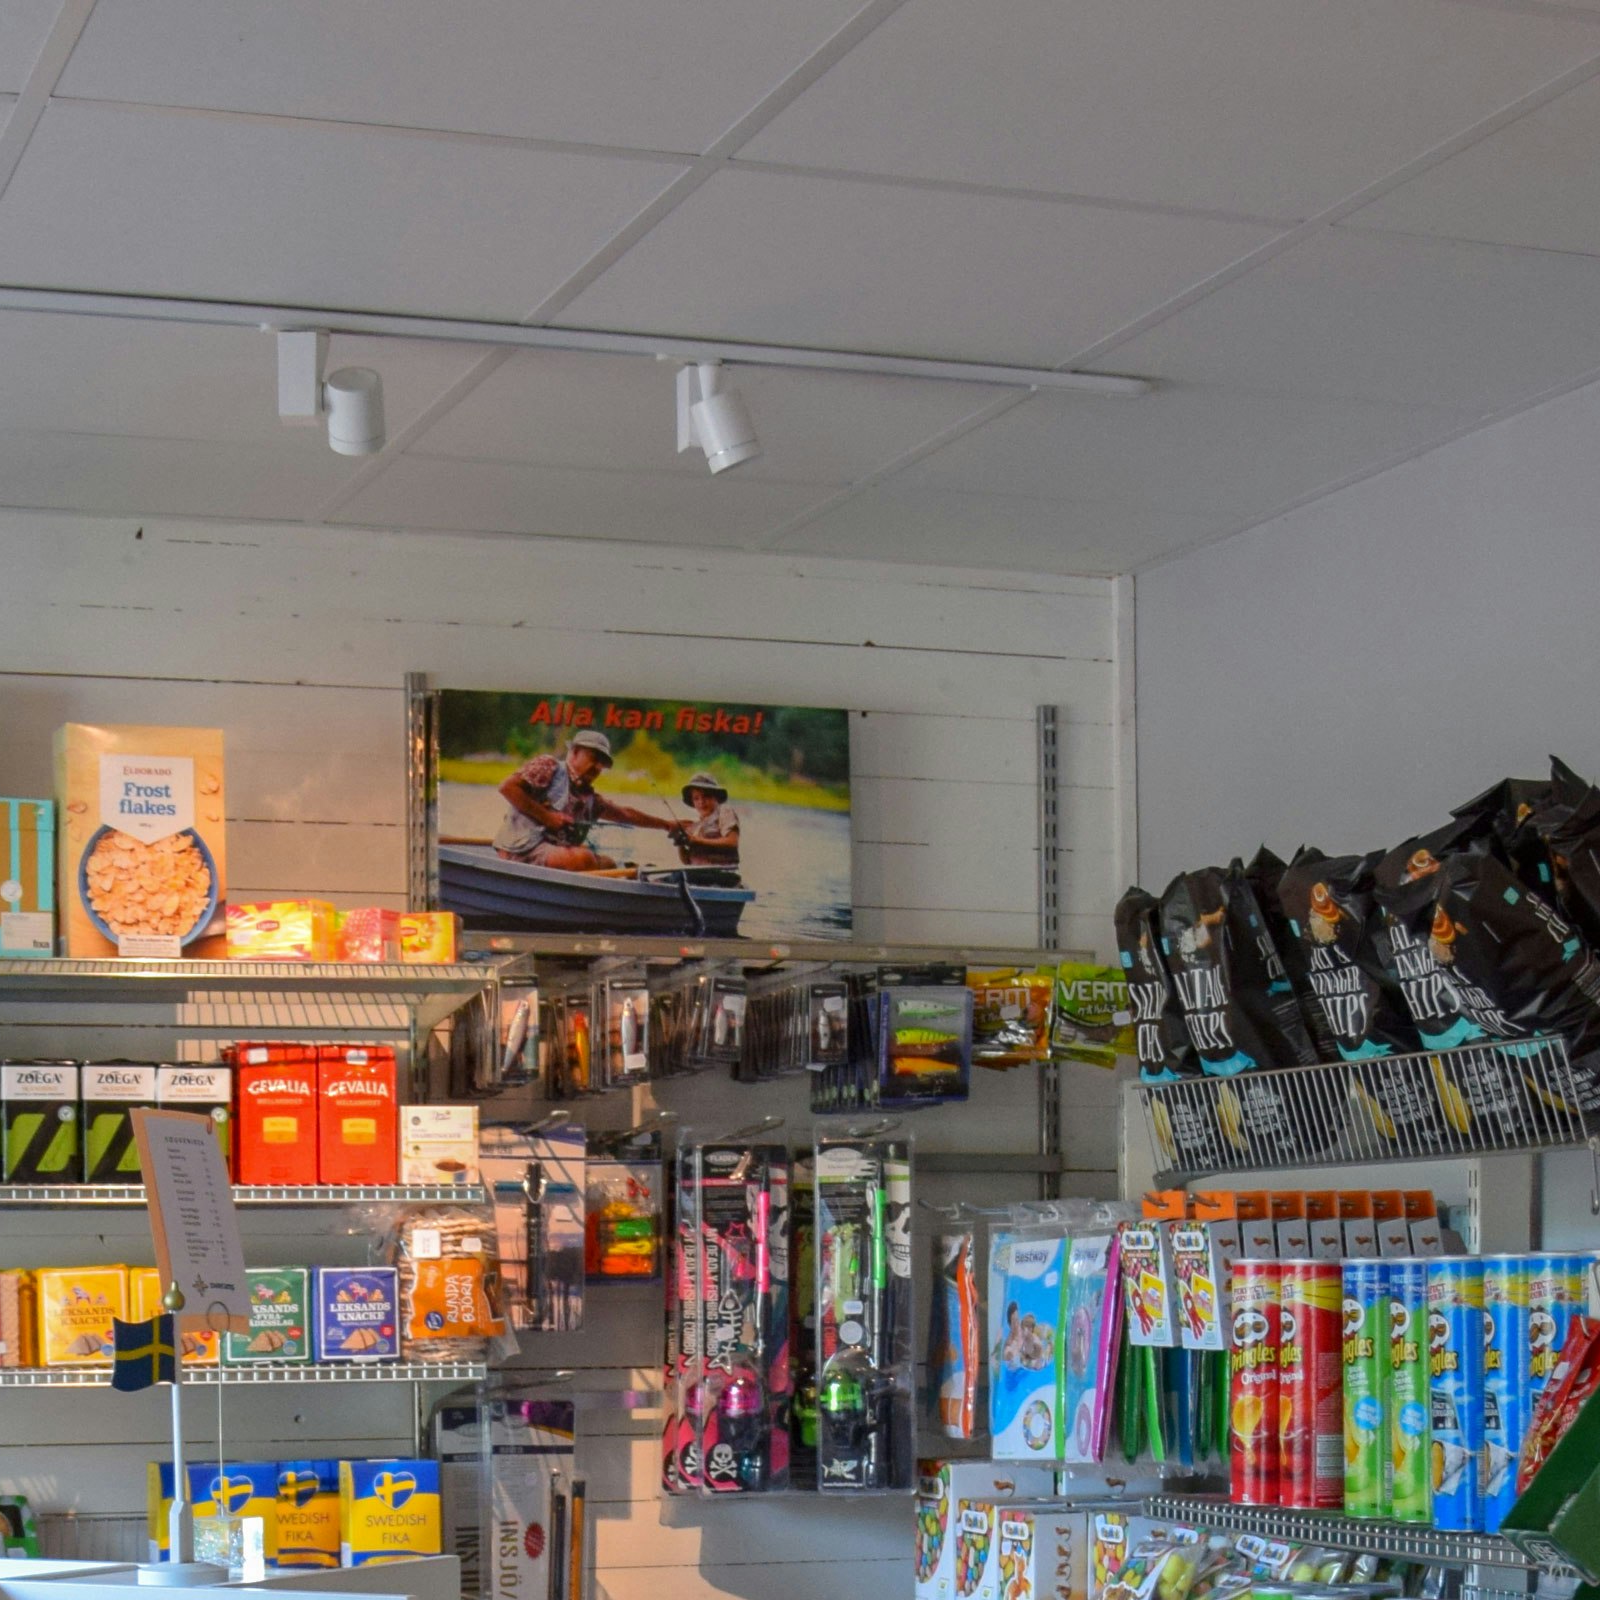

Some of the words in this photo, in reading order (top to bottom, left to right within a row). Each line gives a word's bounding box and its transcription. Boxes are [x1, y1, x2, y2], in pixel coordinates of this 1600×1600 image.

[530, 700, 593, 728] Alla
[605, 706, 663, 730] kan
[675, 707, 764, 734] fiska!
[123, 766, 172, 777] ELDORADO
[124, 782, 171, 799] Frost
[119, 799, 176, 816] flakes
[248, 1079, 311, 1097] GEVALIA
[327, 1081, 389, 1099] GEVALIA
[706, 1245, 719, 1281] DEADLY
[462, 1274, 475, 1322] BJÖRN
[706, 1283, 719, 1321] FISHING
[330, 1302, 391, 1312] LEKSANDS
[683, 1323, 695, 1356] COMBO
[706, 1323, 719, 1356] COMBO
[1241, 1370, 1277, 1385] Original
[277, 1512, 330, 1527] WEDISH
[366, 1513, 427, 1528] SWEDISH
[284, 1529, 314, 1542] FIKA
[381, 1531, 410, 1544] FIKA
